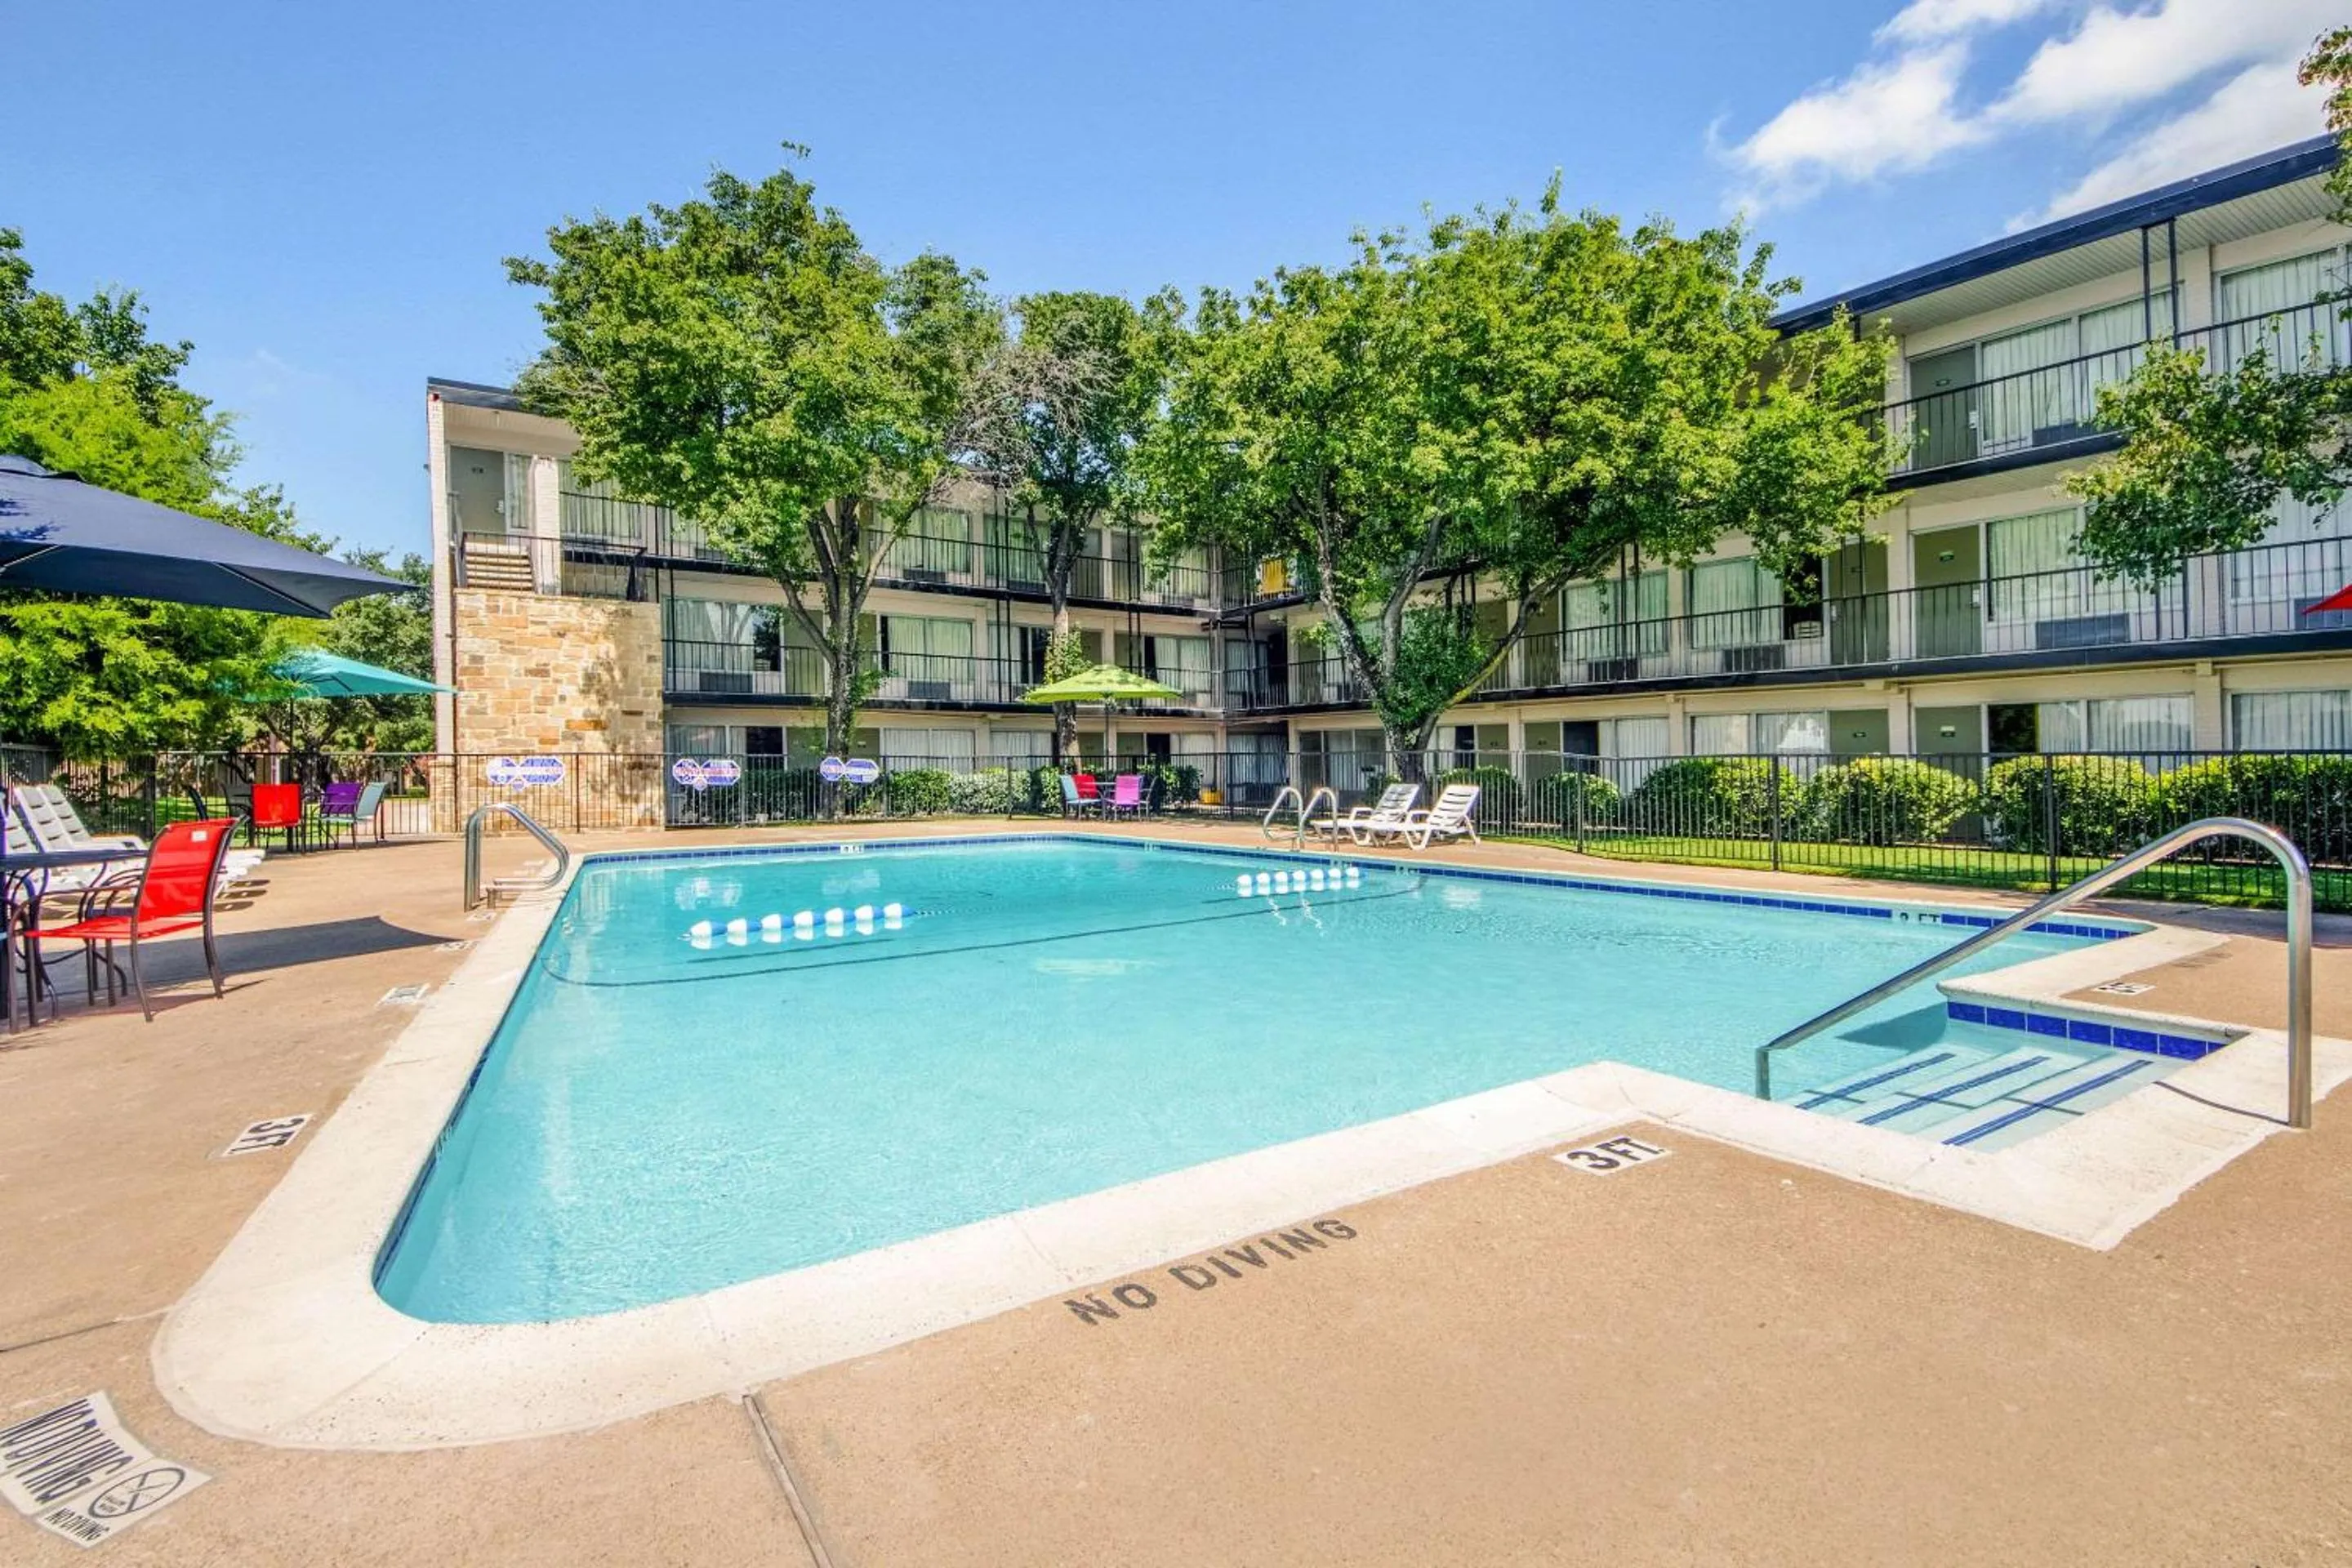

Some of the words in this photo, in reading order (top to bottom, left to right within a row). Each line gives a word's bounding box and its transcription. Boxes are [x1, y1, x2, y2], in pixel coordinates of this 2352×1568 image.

[1062, 1283, 1157, 1325] NO
[1168, 1218, 1357, 1291] DIVING
[0, 1398, 94, 1448] NO
[4, 1419, 134, 1504] DIVING
[43, 1508, 75, 1526] NO
[60, 1515, 109, 1541] DIVING
